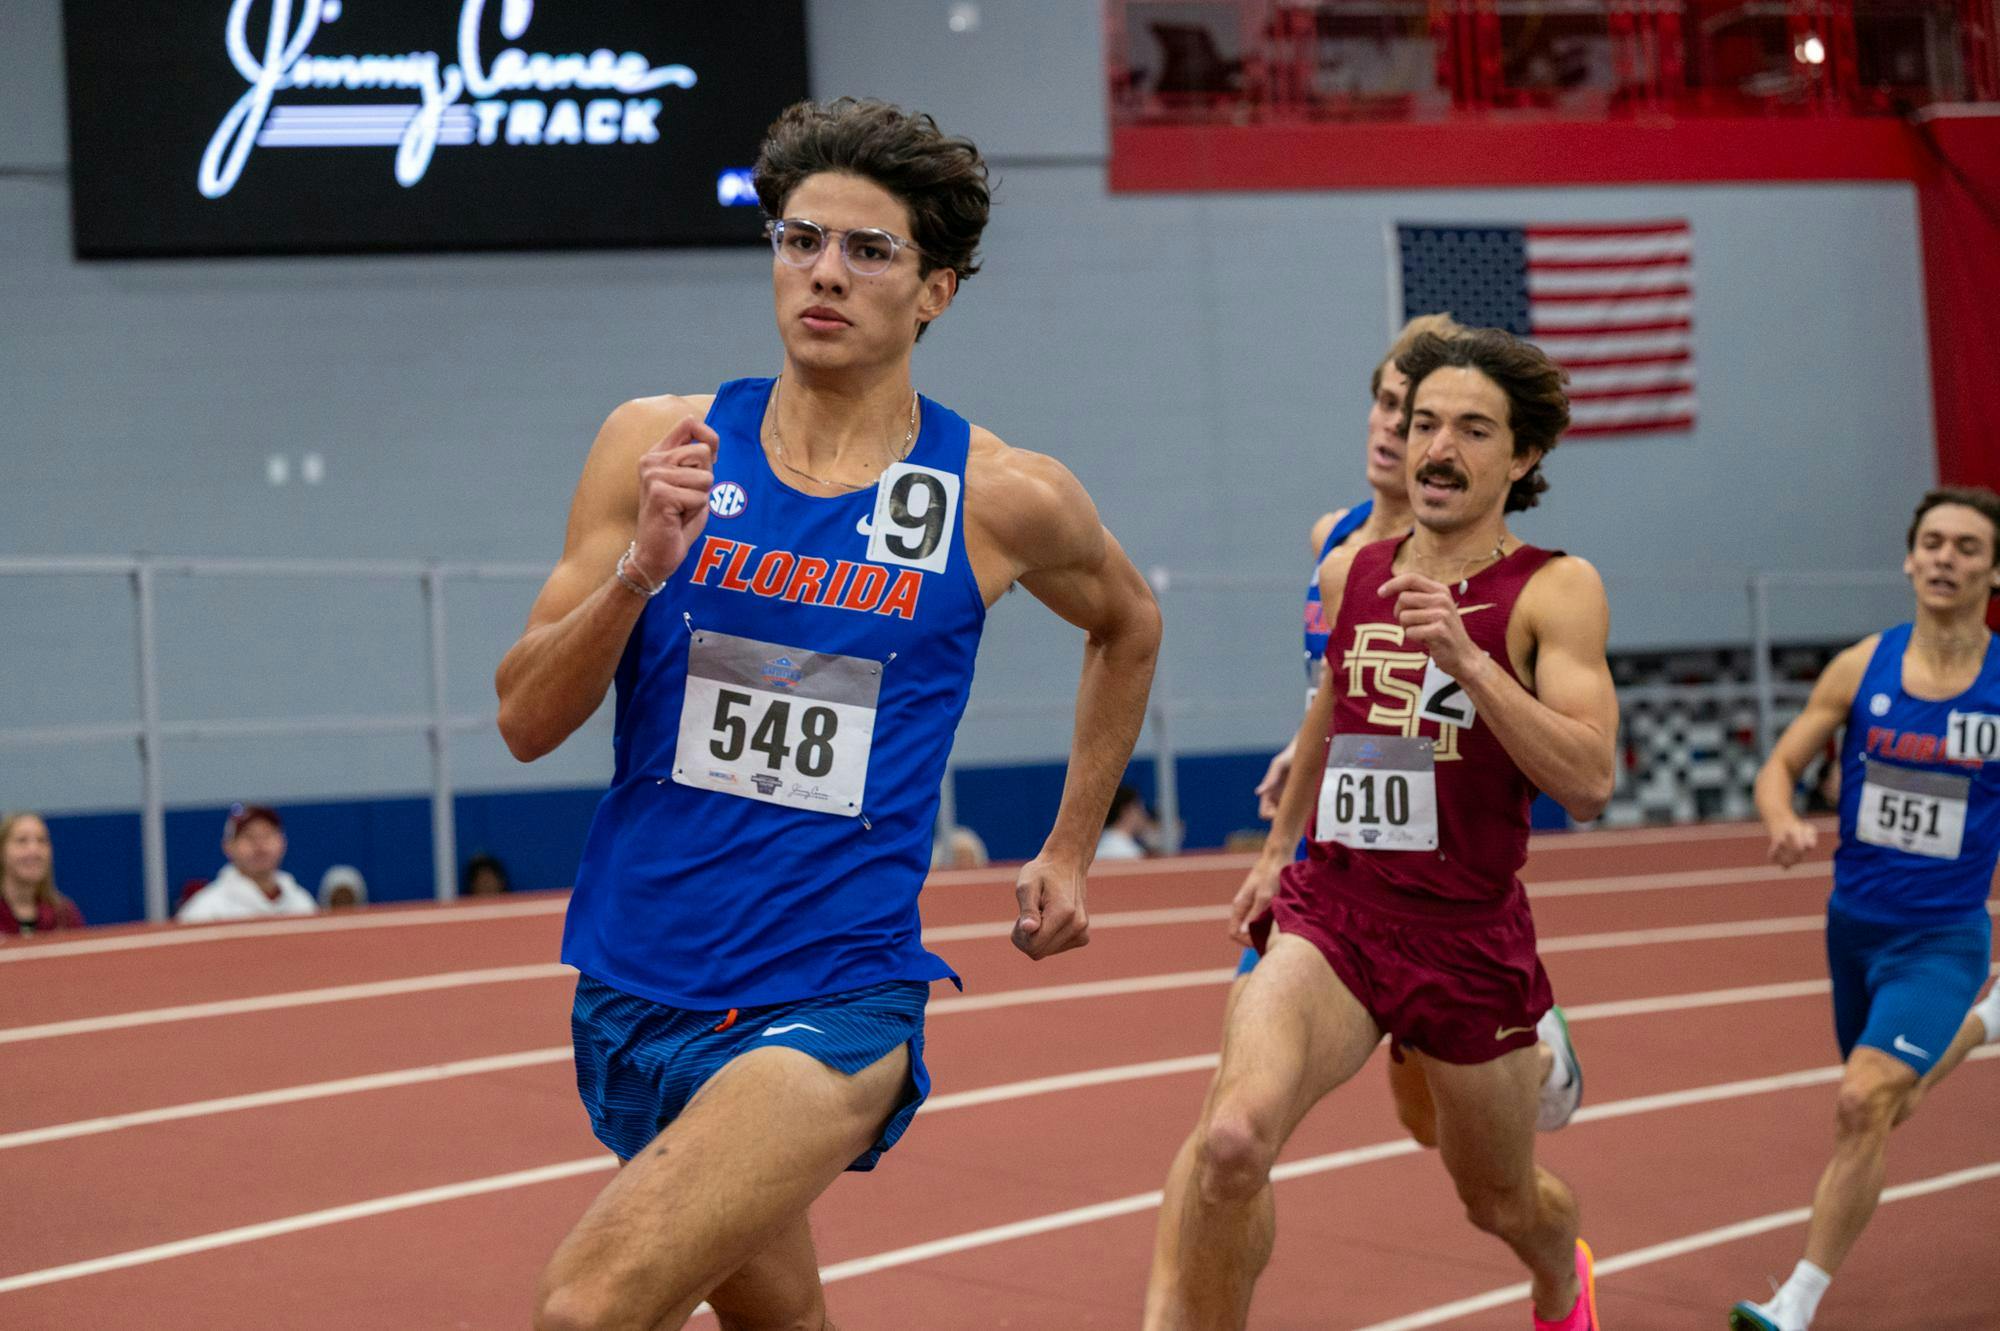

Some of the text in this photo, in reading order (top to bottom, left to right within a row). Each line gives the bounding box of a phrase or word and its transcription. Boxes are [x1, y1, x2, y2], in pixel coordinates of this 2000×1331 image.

[474, 98, 662, 146] TRACK
[709, 483, 745, 516] SEC
[885, 472, 947, 560] 9
[690, 535, 923, 620] FLORIDA
[709, 688, 838, 778] 548
[1954, 718, 1997, 756] 10
[1335, 773, 1410, 826] 610
[1877, 794, 1941, 838] 551
